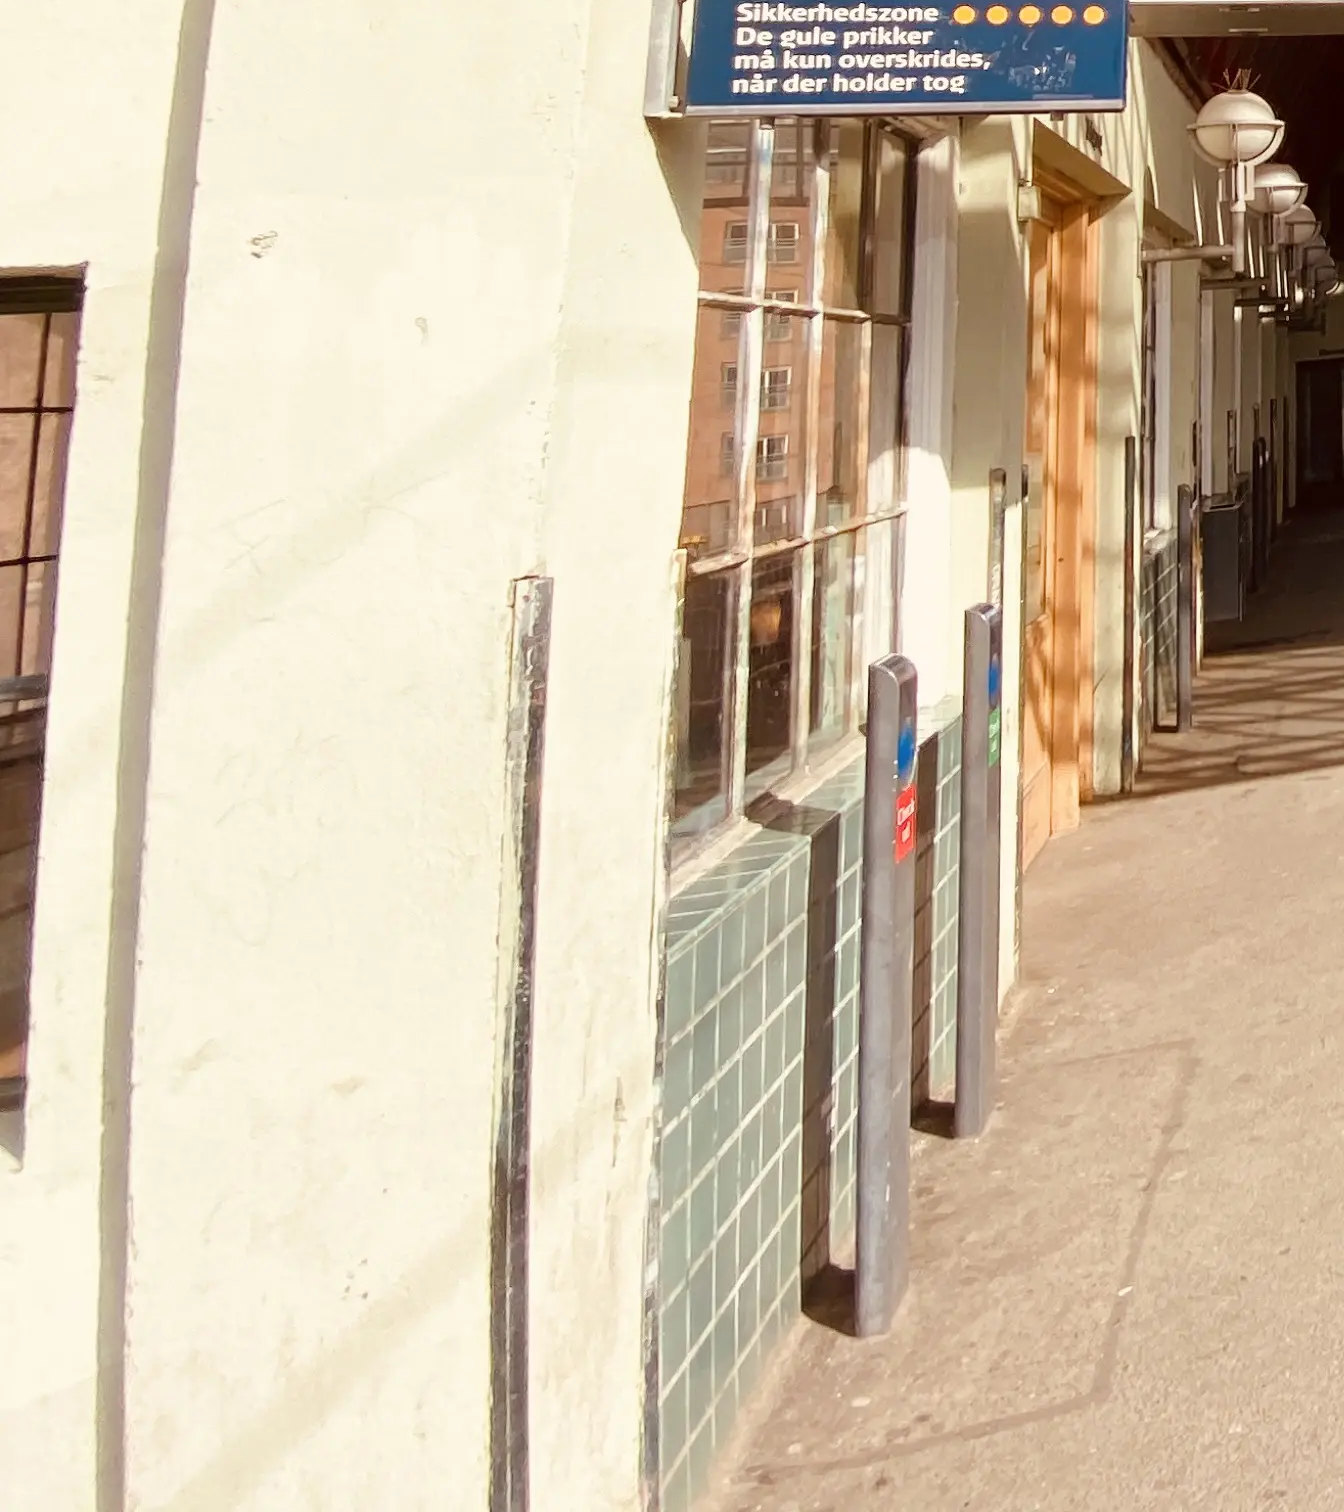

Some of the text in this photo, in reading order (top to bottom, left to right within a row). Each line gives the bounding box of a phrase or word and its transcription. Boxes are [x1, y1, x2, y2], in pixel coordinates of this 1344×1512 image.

[736, 2, 939, 22] Sikkerhedszone
[735, 26, 934, 50] De gule prikker
[734, 49, 991, 71] må kun overskrides,
[732, 71, 965, 95] når der holder tog
